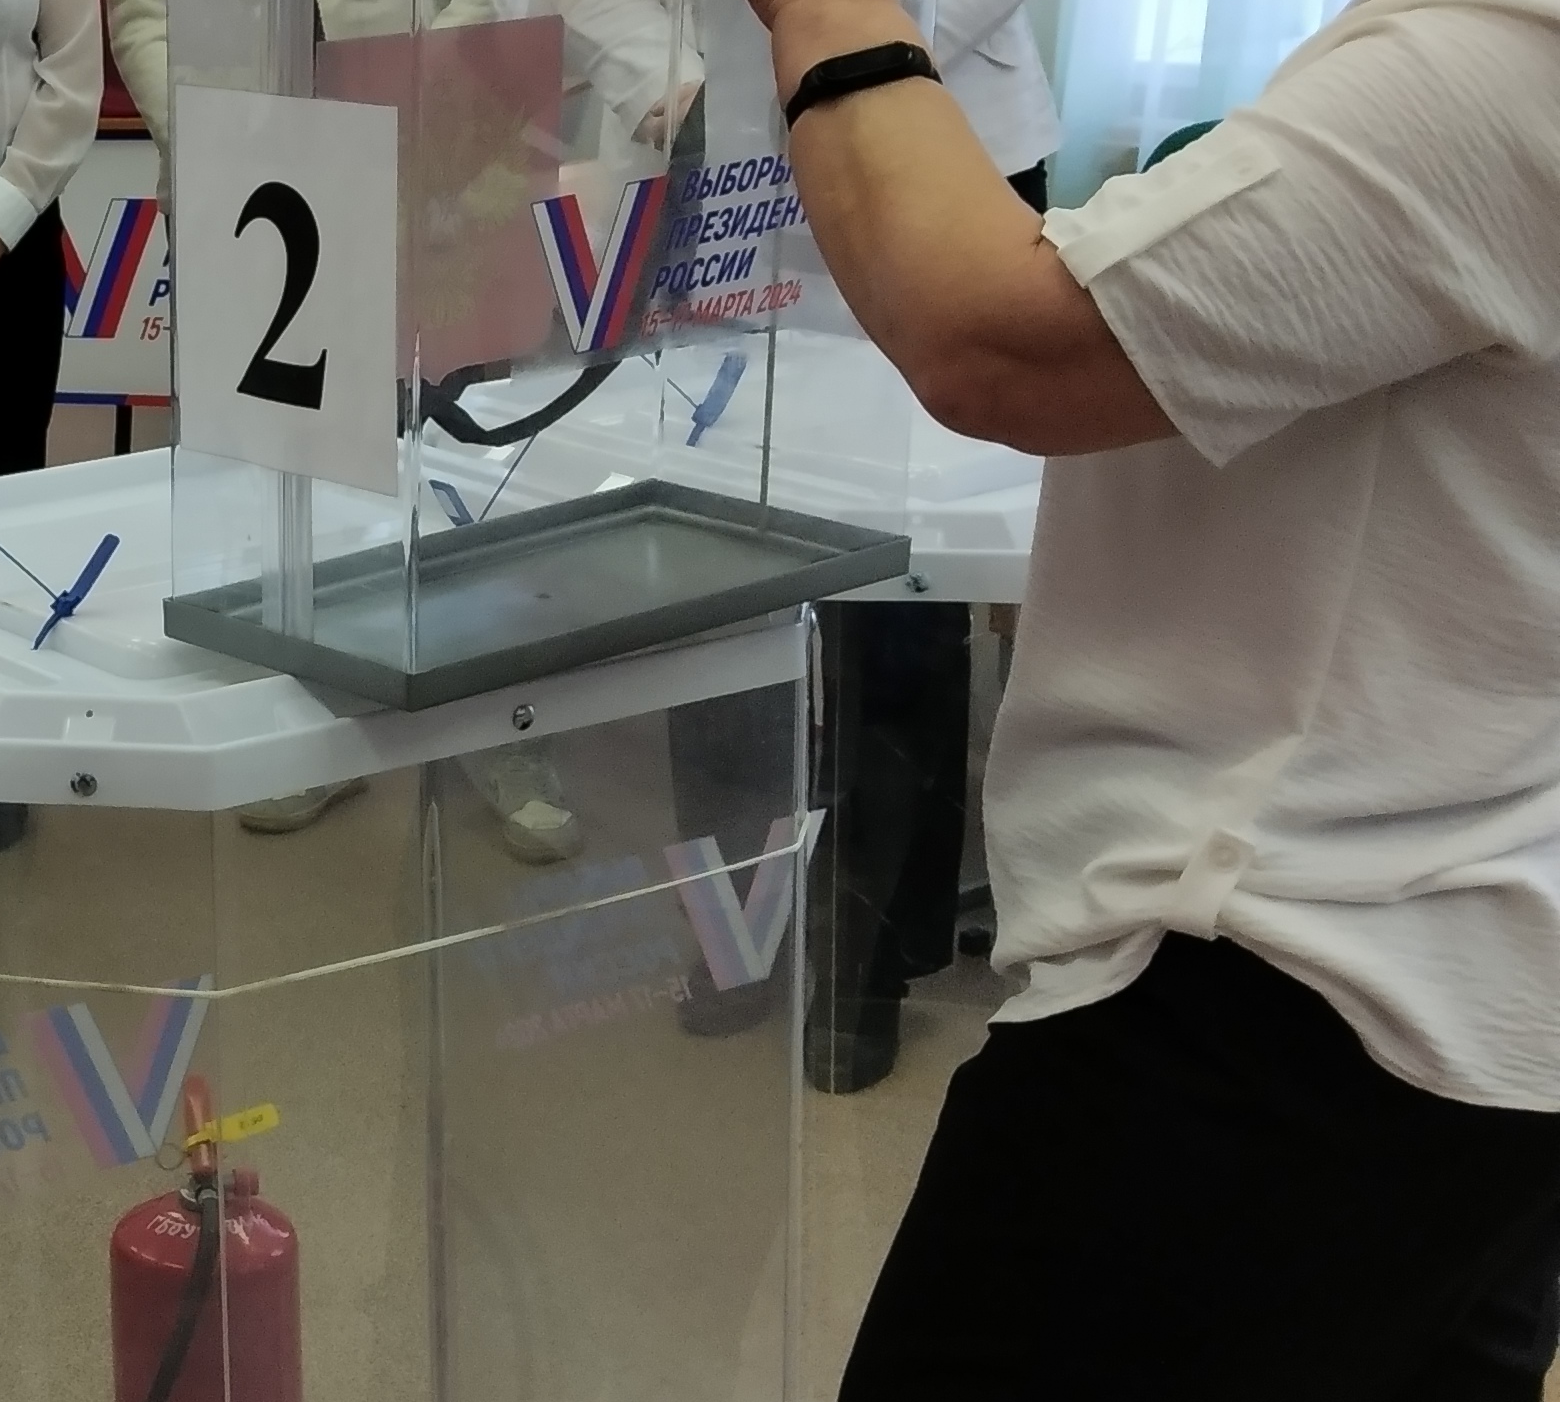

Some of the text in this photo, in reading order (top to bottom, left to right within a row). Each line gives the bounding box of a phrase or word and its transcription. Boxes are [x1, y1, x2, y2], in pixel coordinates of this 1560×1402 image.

[664, 196, 808, 250] ПРЕЗИДЕН
[234, 180, 327, 411] 2
[650, 246, 758, 299] РОССИИ
[694, 289, 756, 324] МАРТА
[756, 279, 803, 314] 2024
